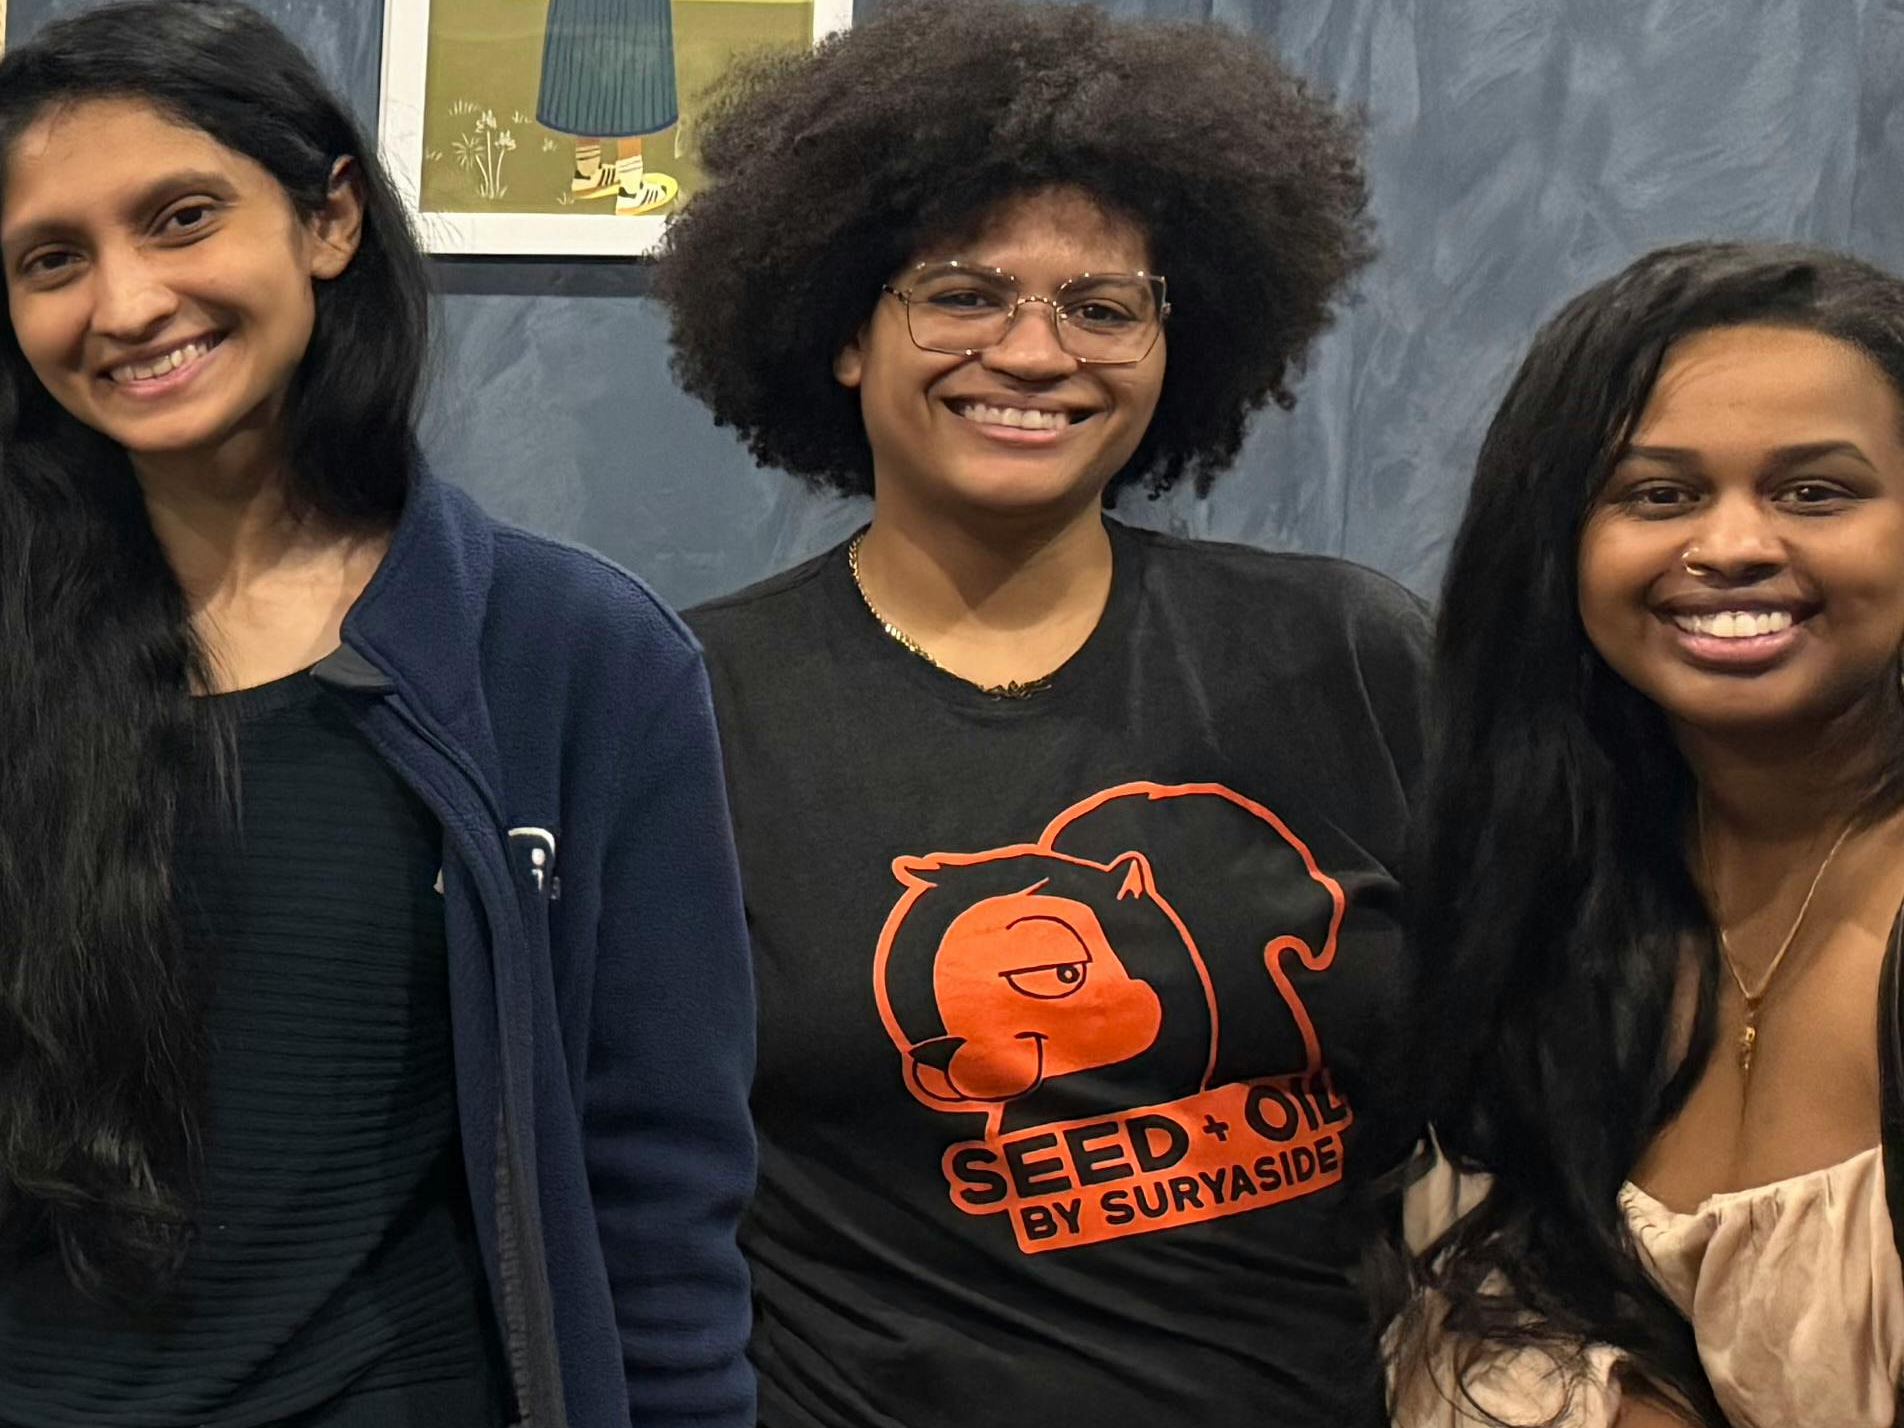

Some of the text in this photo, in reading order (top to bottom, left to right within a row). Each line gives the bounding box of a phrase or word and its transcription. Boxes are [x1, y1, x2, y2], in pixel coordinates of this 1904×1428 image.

[951, 1114, 1190, 1205] SEED
[1244, 1078, 1349, 1141] OIL
[1021, 1140, 1339, 1241] BY SURYASIDE
